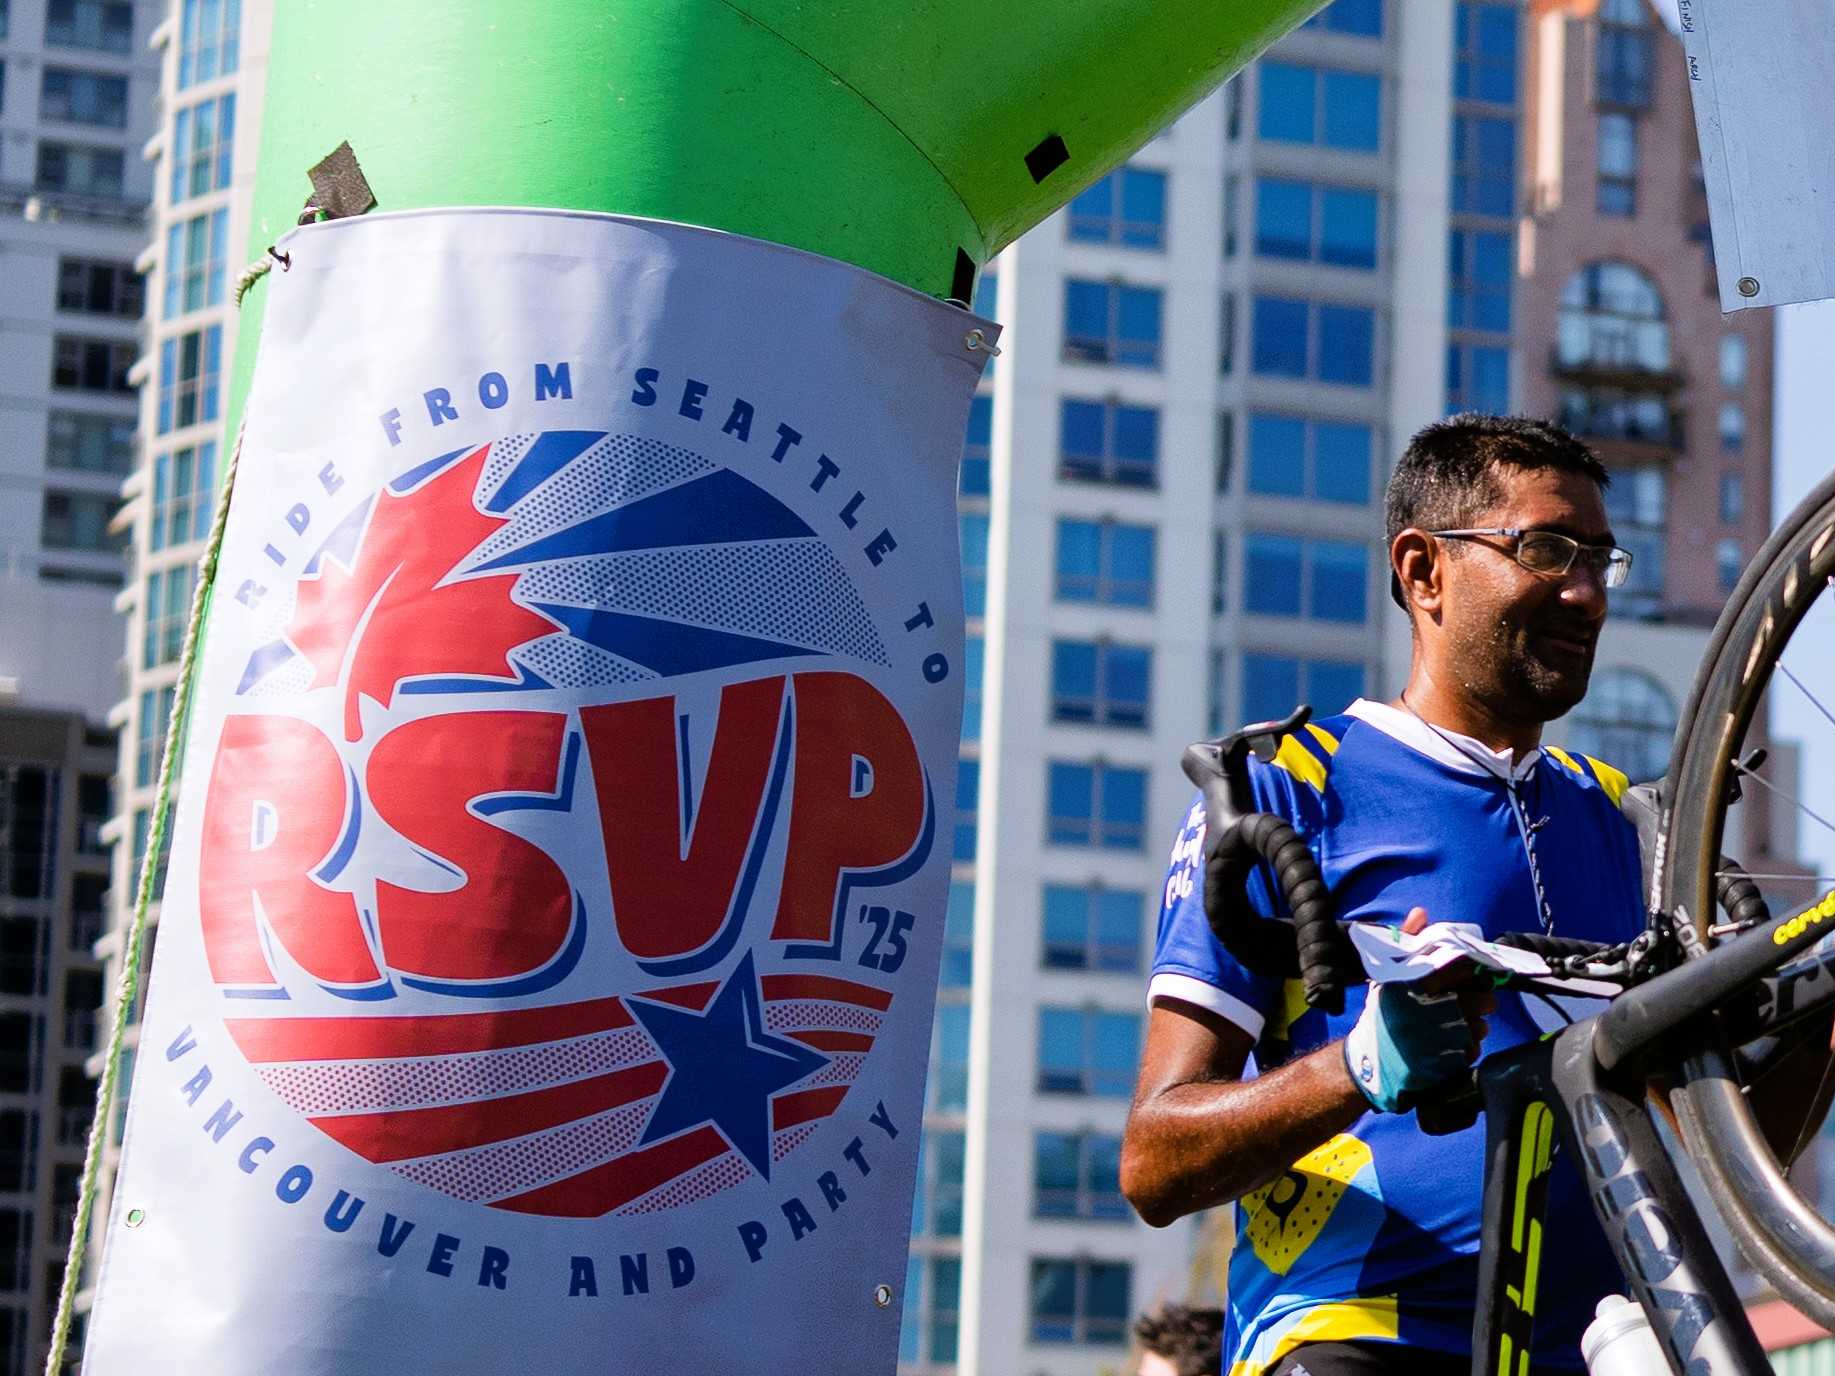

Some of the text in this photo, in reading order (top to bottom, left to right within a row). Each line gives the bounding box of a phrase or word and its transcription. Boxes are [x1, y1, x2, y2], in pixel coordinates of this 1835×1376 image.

[233, 361, 951, 686] RIDE FROM SEATTLE TO
[199, 669, 937, 1001] RSVP
[857, 906, 915, 975] '25
[166, 1022, 903, 1300] VANCOUVER AND PARTY
